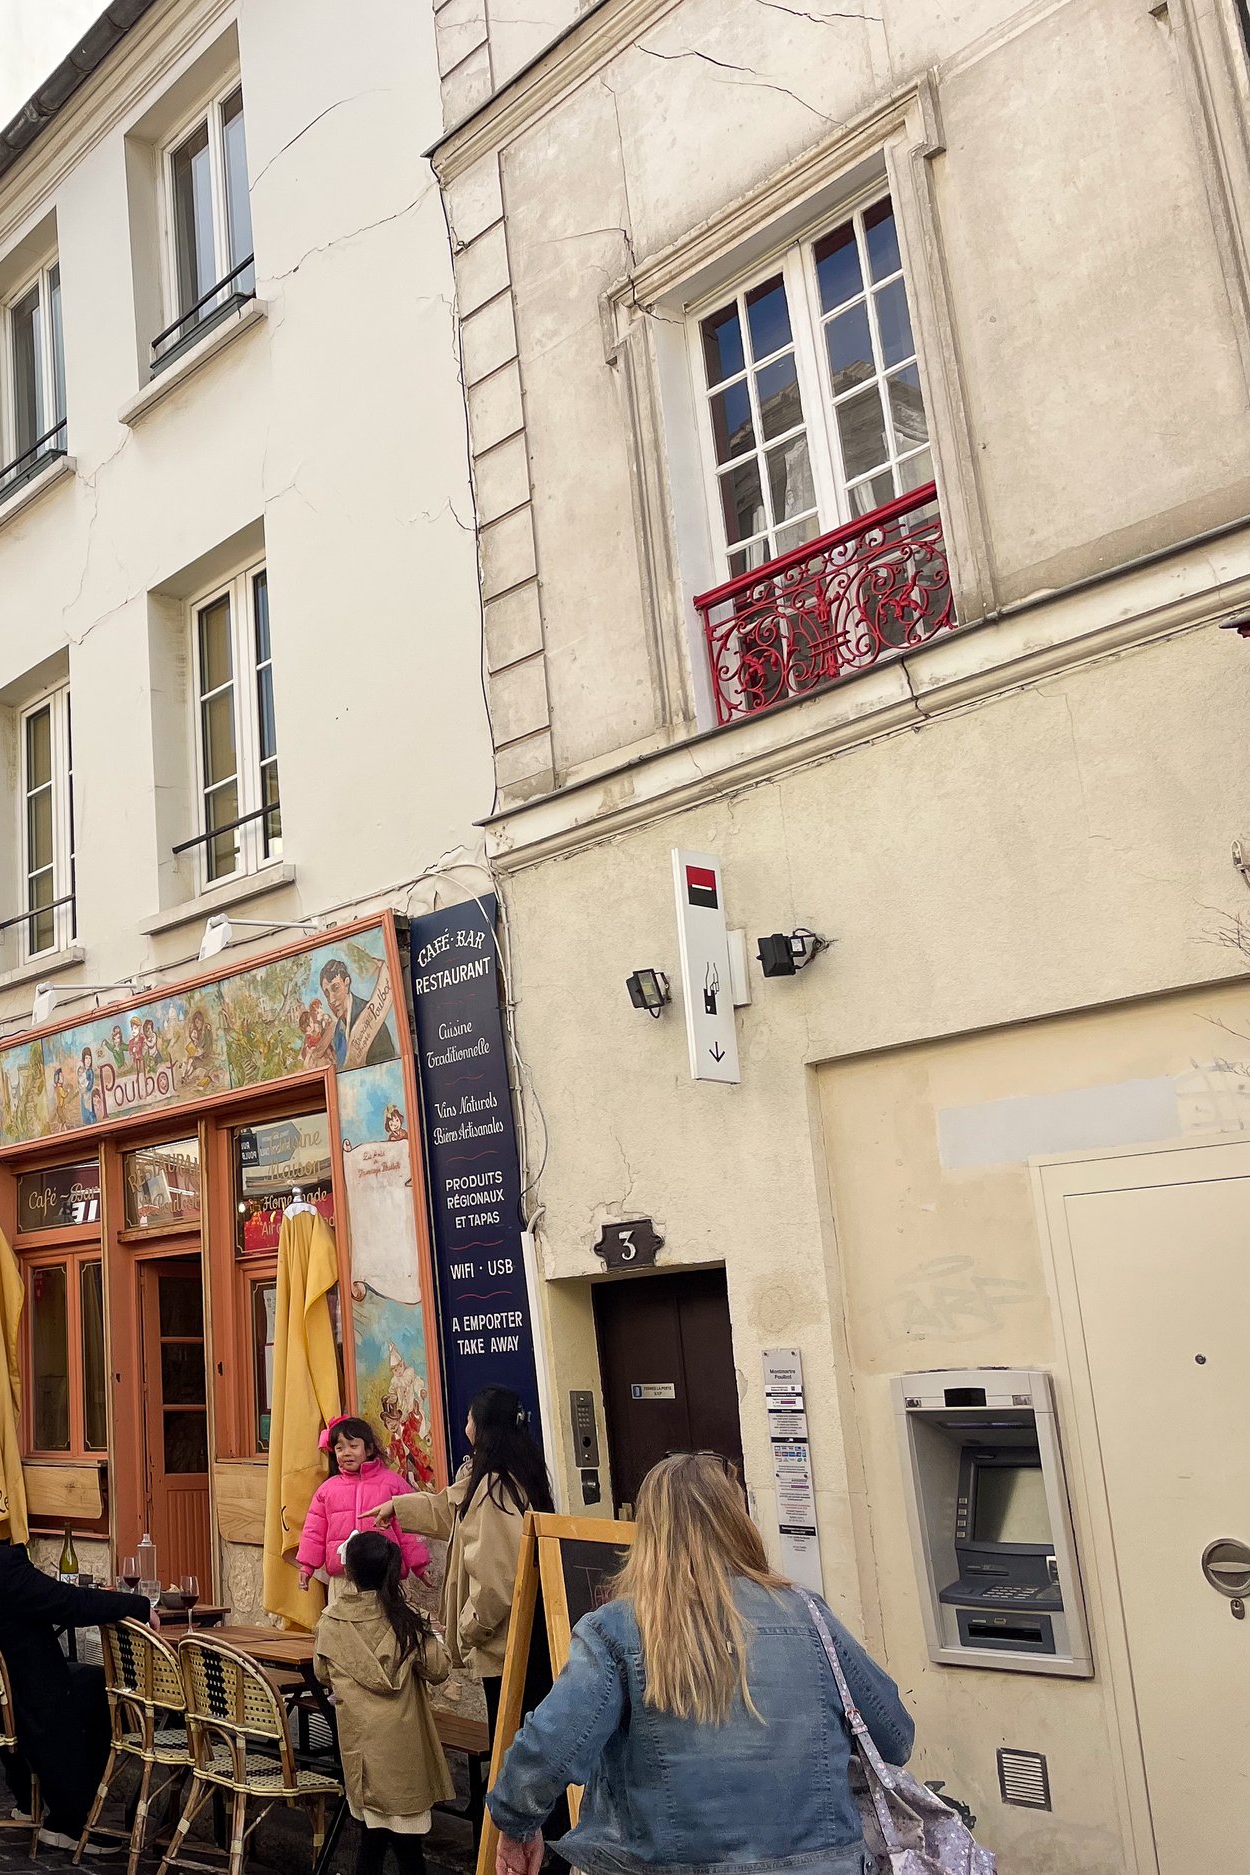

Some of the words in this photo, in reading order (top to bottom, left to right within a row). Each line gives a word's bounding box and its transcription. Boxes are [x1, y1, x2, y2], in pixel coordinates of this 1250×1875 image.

[417, 928, 450, 967] CAFÉ
[455, 929, 486, 949] BAR
[415, 956, 491, 995] RESTAURANT
[438, 1019, 473, 1040] Cuisine
[426, 1037, 491, 1069] Traditionnelle
[97, 1053, 178, 1119] Poulbot
[434, 1101, 457, 1118] Vins
[459, 1091, 498, 1114] Naturels
[458, 1116, 504, 1140] Artisanales
[445, 1170, 503, 1192] PRODUITS
[28, 1187, 57, 1217] Café
[69, 1182, 97, 1205] Bar
[447, 1188, 505, 1210] RÉGIONAUX
[455, 1216, 466, 1229] ET
[468, 1211, 500, 1227] TAPAS
[617, 1230, 637, 1261] 3
[450, 1263, 474, 1280] WIFI
[487, 1258, 514, 1276] USB
[452, 1317, 461, 1332] A
[463, 1311, 523, 1332] EMPORTER
[457, 1338, 485, 1355] TAKE
[490, 1335, 519, 1353] AWAY
